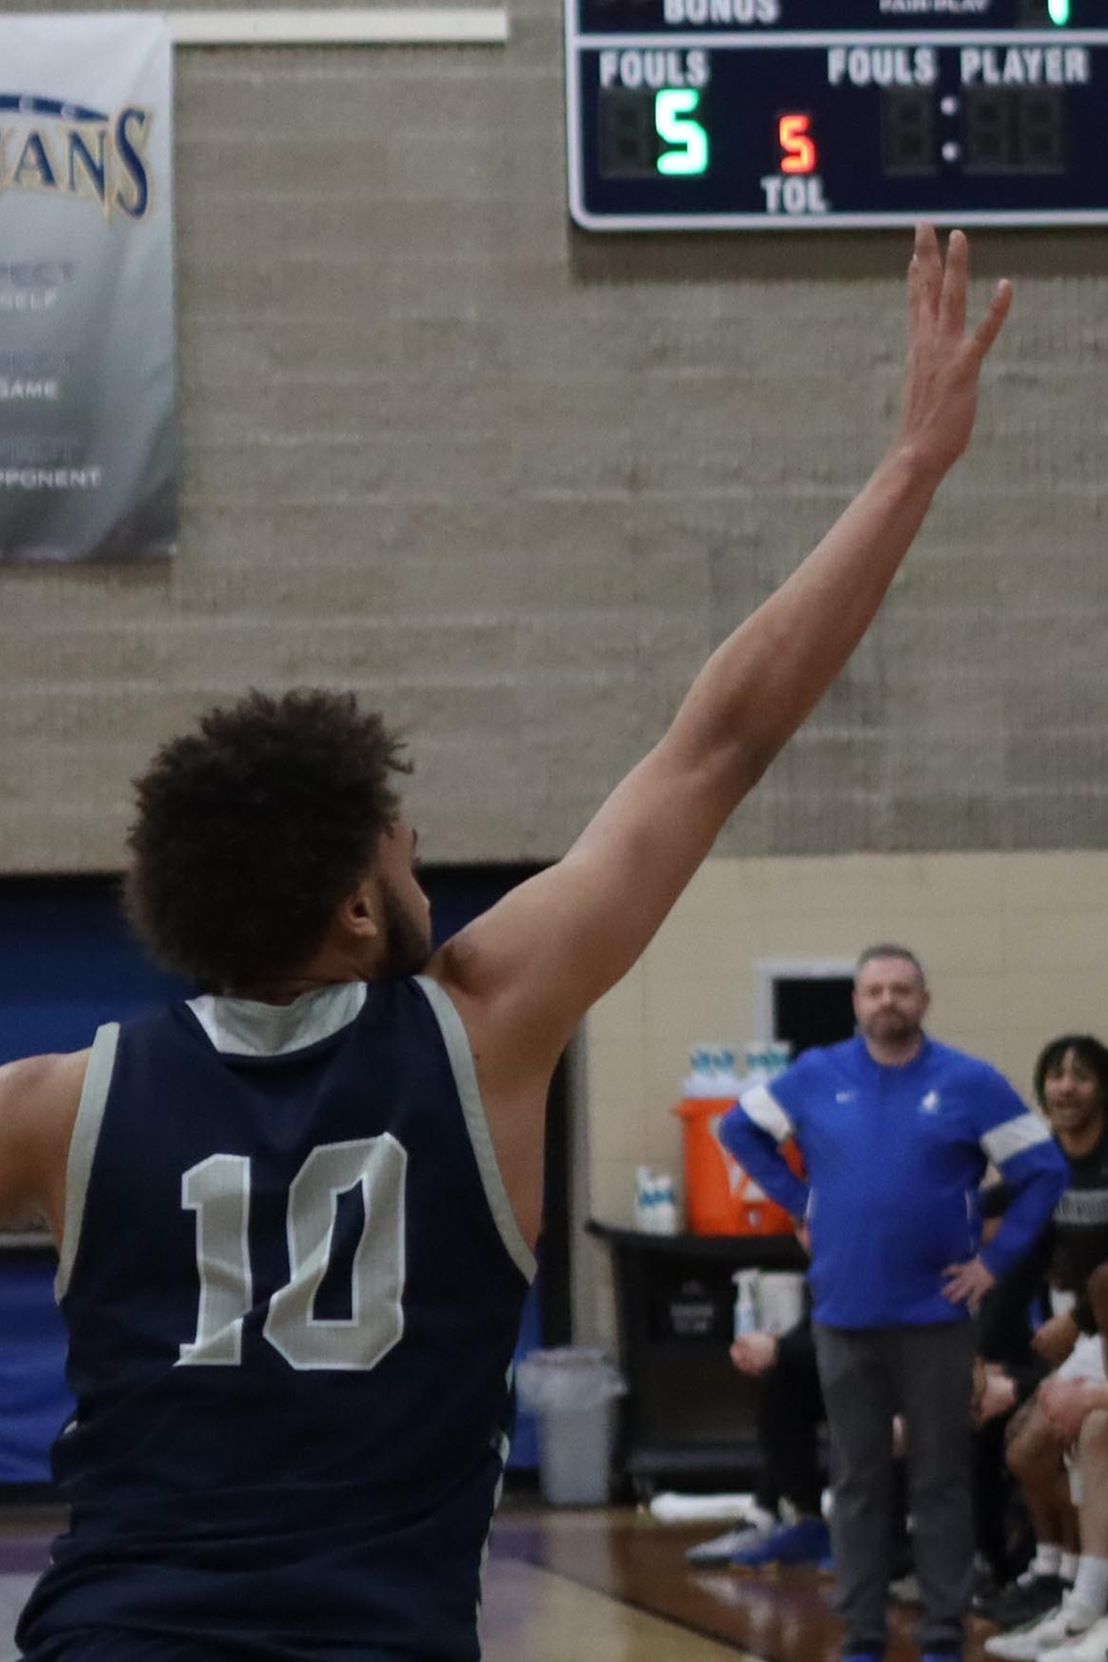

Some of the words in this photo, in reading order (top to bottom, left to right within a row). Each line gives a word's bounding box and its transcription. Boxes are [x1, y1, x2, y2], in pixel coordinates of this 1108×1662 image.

[663, 0, 781, 25] BONUS
[599, 50, 710, 88] FOULS
[827, 47, 938, 86] FOULS
[960, 46, 1091, 85] PLAYER
[655, 88, 709, 176] 5
[778, 114, 816, 174] 5
[0, 107, 150, 220] ANS
[760, 175, 829, 214] TOL
[173, 1132, 408, 1370] 10
